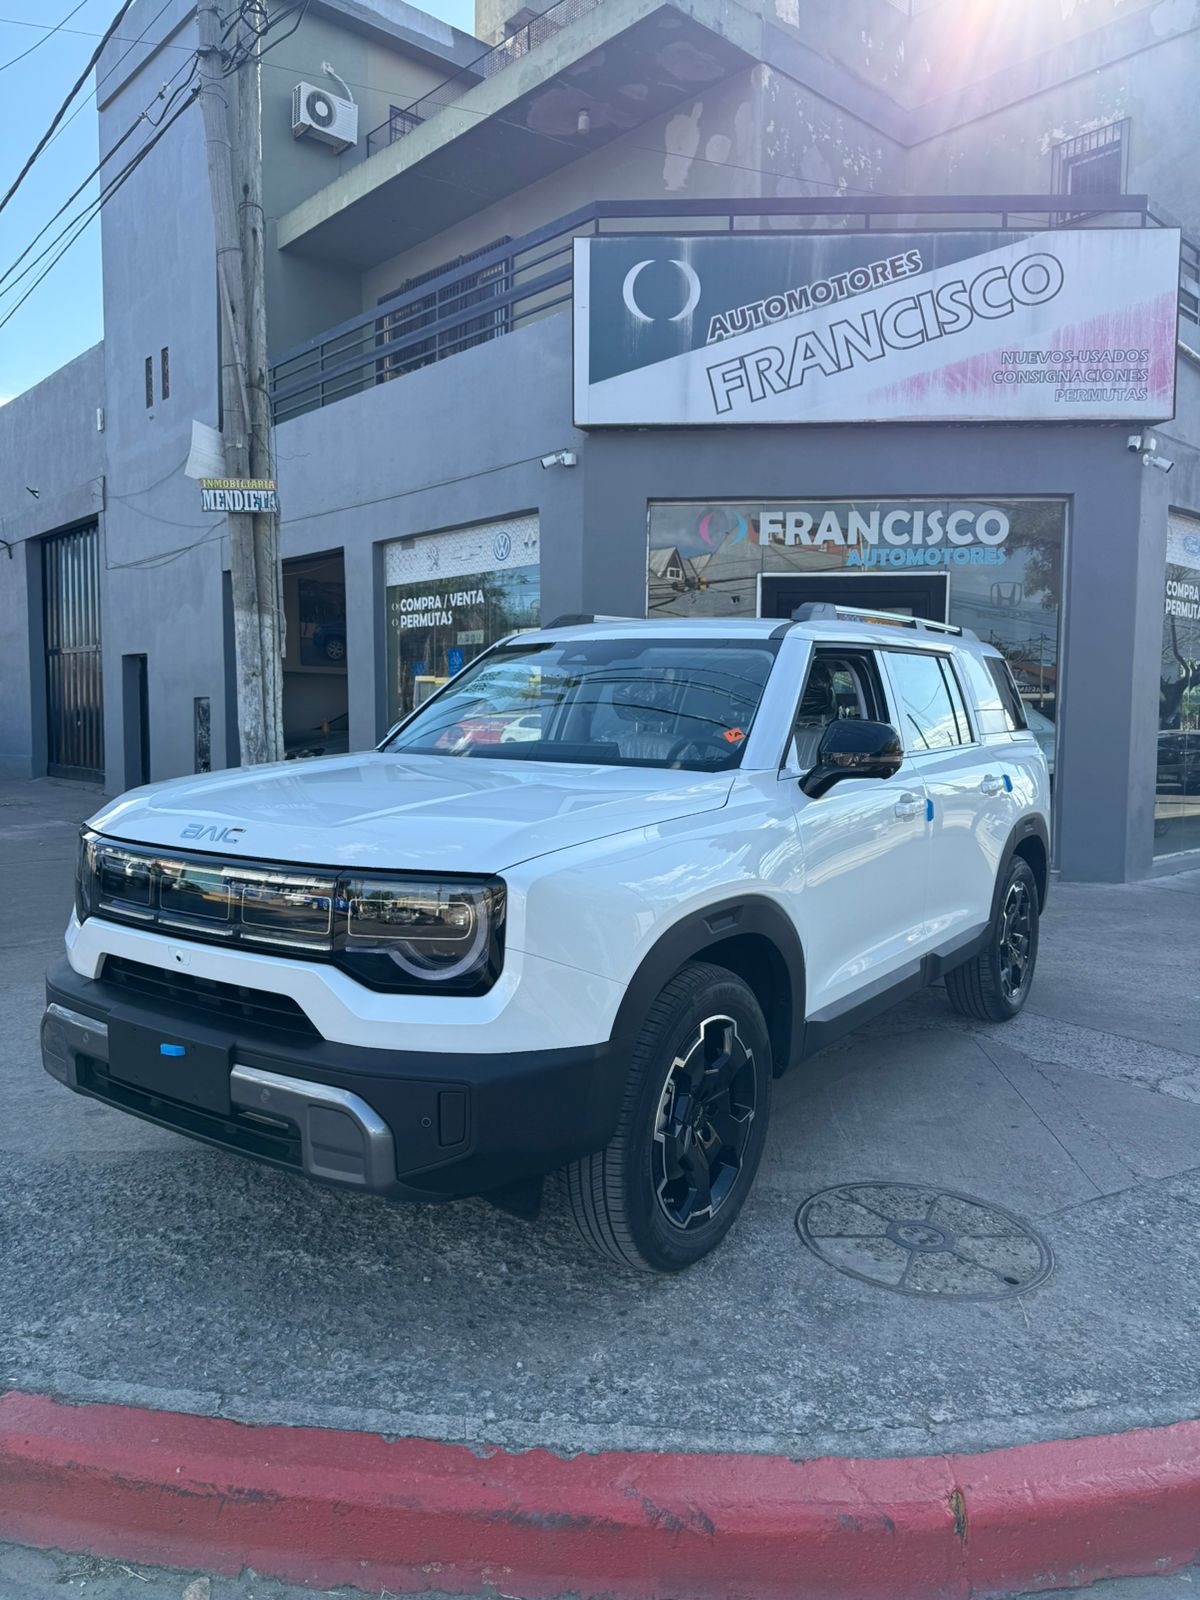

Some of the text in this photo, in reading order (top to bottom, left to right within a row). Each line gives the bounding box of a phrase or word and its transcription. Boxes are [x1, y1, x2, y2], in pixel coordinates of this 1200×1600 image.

[706, 249, 922, 342] AUTOMOTORES
[706, 252, 1064, 414] FRANCISCO
[1000, 349, 1150, 365] NUEVOS-USADOS
[991, 368, 1149, 384] CONSIGNACIONES
[1054, 387, 1148, 402] PERMUTAS
[202, 479, 275, 489] INMOBILIARIA
[201, 489, 277, 512] MENDIETA
[758, 509, 1010, 545] FRANCISCO
[846, 547, 1006, 567] AUTOMOTORES
[1166, 580, 1199, 601] COMPRA
[400, 594, 442, 612] COMPRA
[450, 590, 484, 606] VENTA
[400, 611, 453, 629] PERMUTAS
